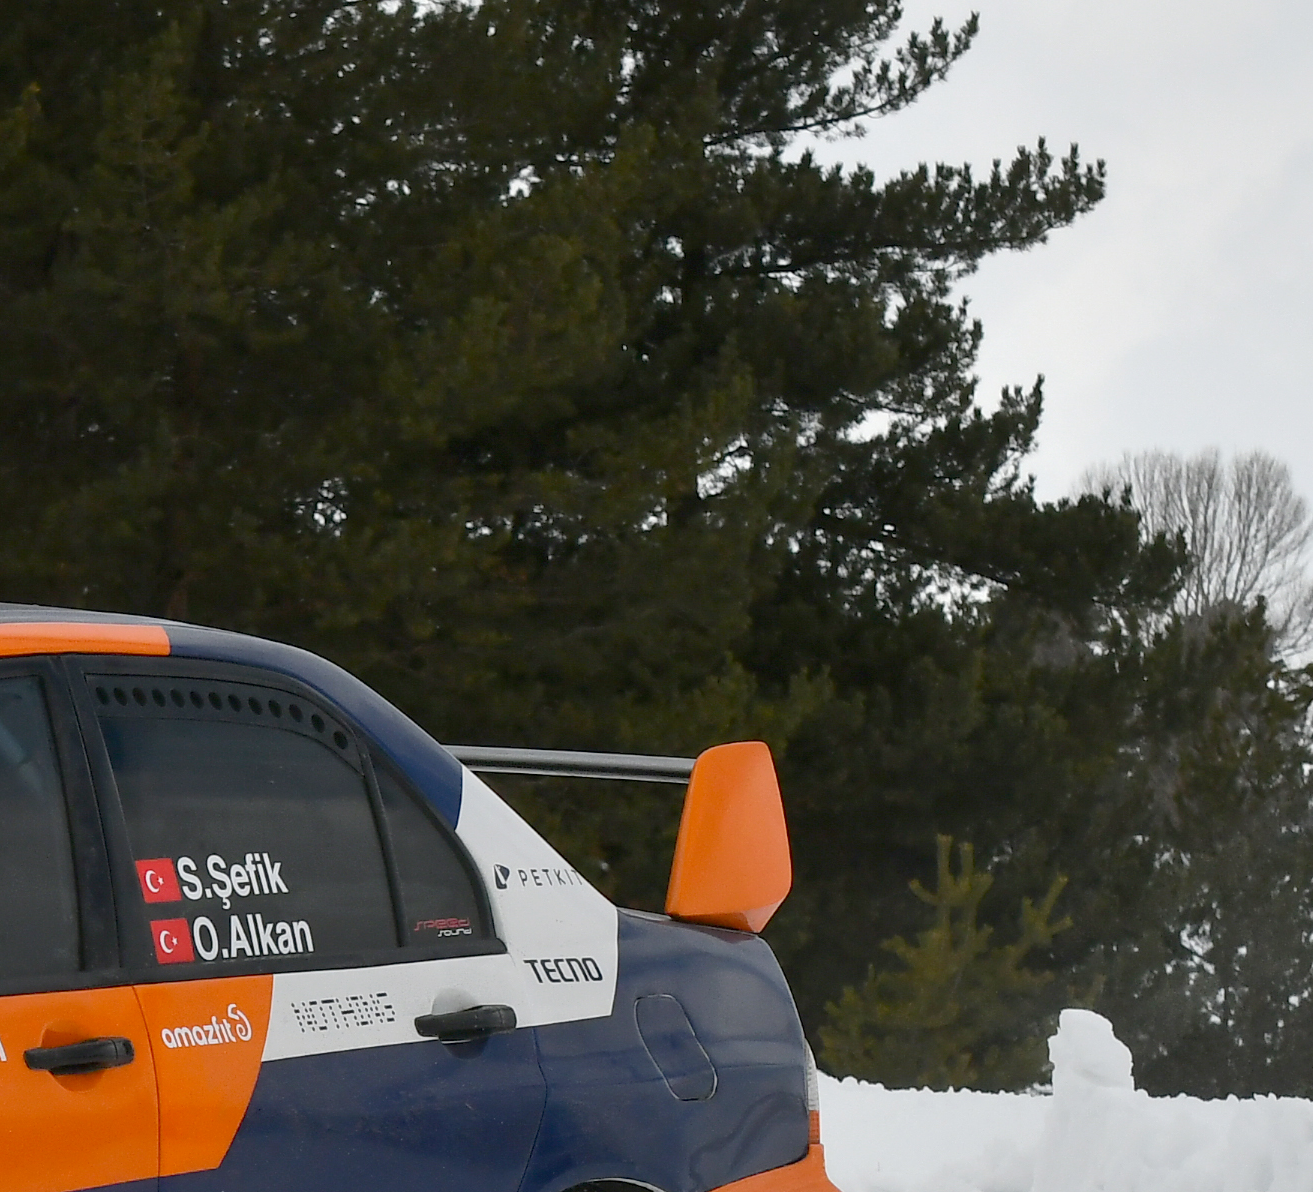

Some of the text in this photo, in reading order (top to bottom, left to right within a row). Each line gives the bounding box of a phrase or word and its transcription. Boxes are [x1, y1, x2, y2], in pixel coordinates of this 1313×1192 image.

[176, 852, 289, 909] S.Şefik
[517, 868, 583, 887] PETKIT
[193, 913, 315, 962] O.Alkan
[523, 957, 604, 983] TECNO
[161, 1012, 237, 1050] amazfit
[290, 992, 397, 1033] NOTHING
